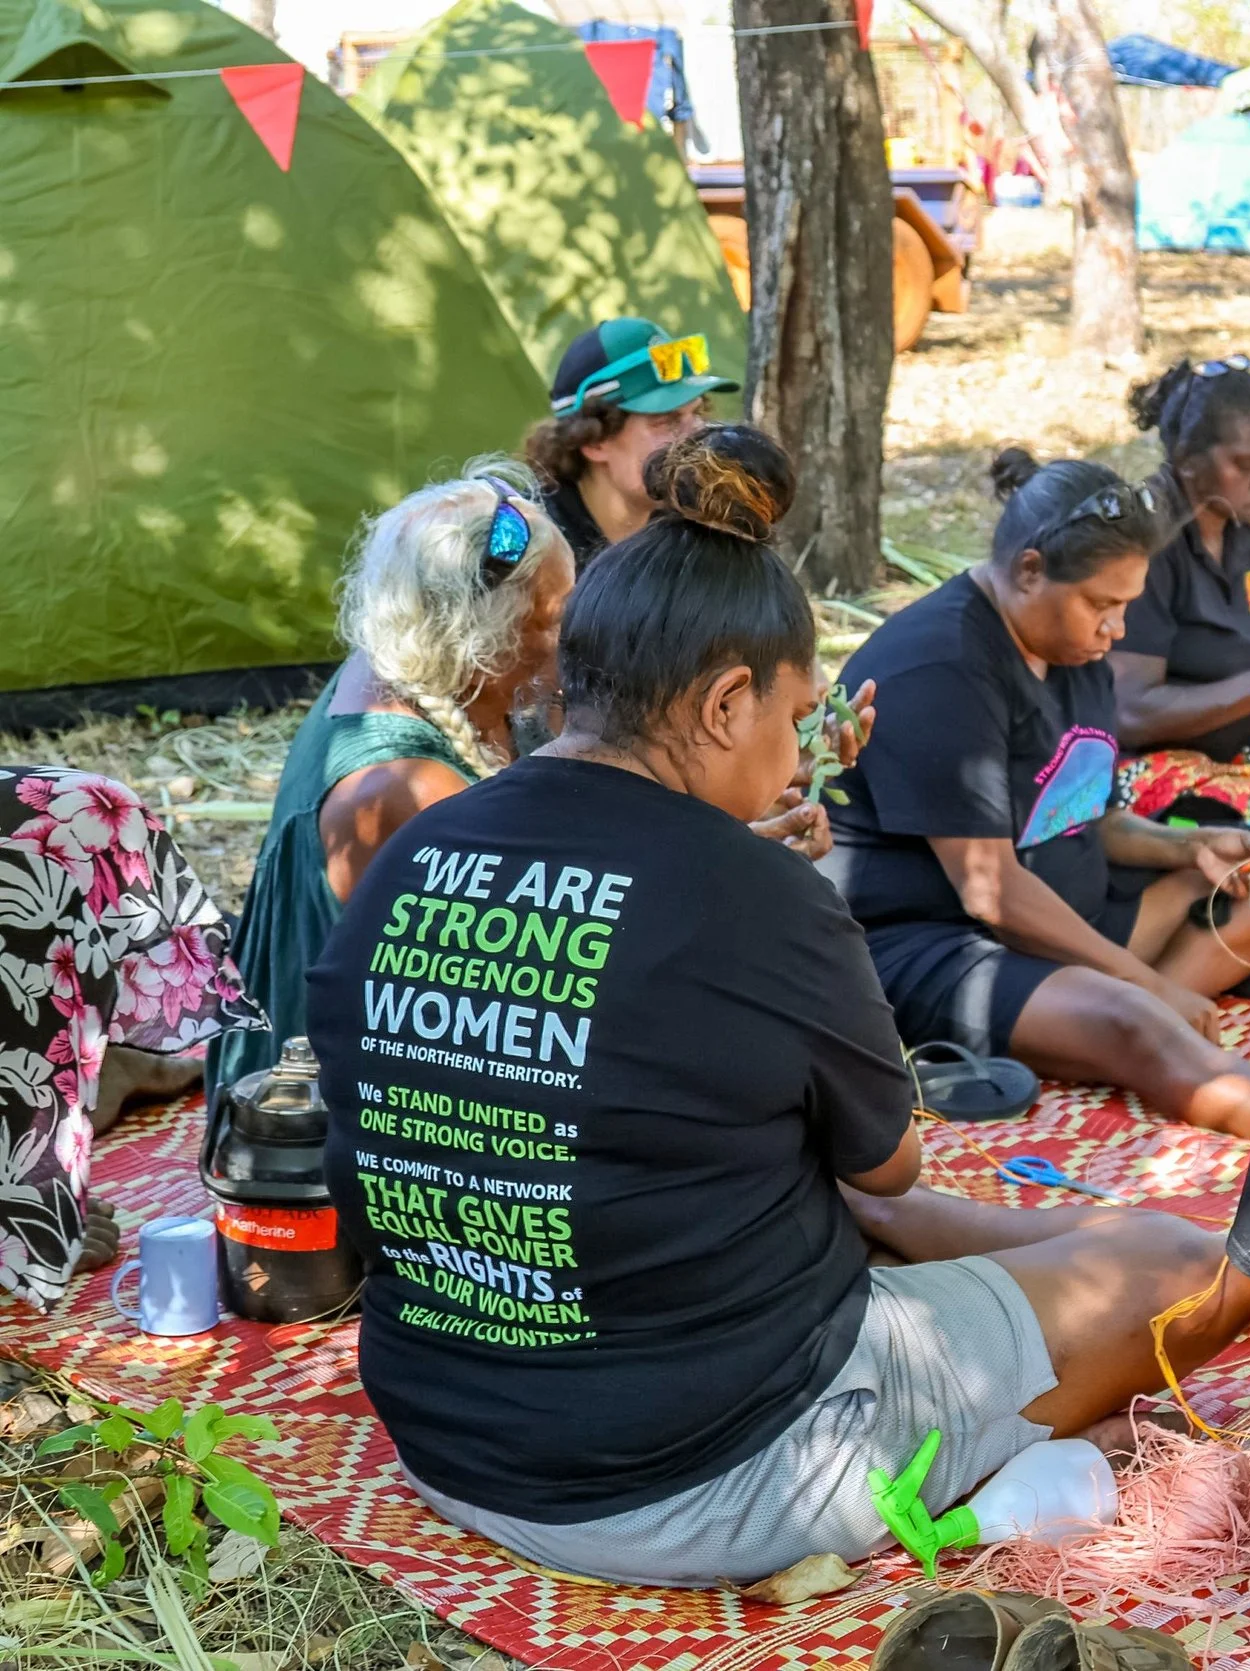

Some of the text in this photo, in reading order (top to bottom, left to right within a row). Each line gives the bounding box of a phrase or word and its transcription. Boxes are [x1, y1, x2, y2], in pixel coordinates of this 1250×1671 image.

[412, 847, 633, 920] “WE ARE
[383, 894, 614, 970] STRONG
[369, 942, 598, 1009] INDIGENOUS
[364, 980, 592, 1067] WOMEN
[361, 1036, 583, 1091] OF THE NORTHERN TERRITORY.
[357, 1081, 579, 1139] We STAND UNITED as
[360, 1108, 577, 1162] ONE STRONG VOICE.
[356, 1150, 573, 1201] WE COMMIT TO A NETWORK
[357, 1172, 572, 1241] THAT GIVES
[365, 1206, 578, 1268] EQUAL POWER
[381, 1241, 584, 1302] to the RIGHTS of
[393, 1261, 591, 1324] ALL OUR WOMEN.
[399, 1303, 474, 1337] HEALTHY
